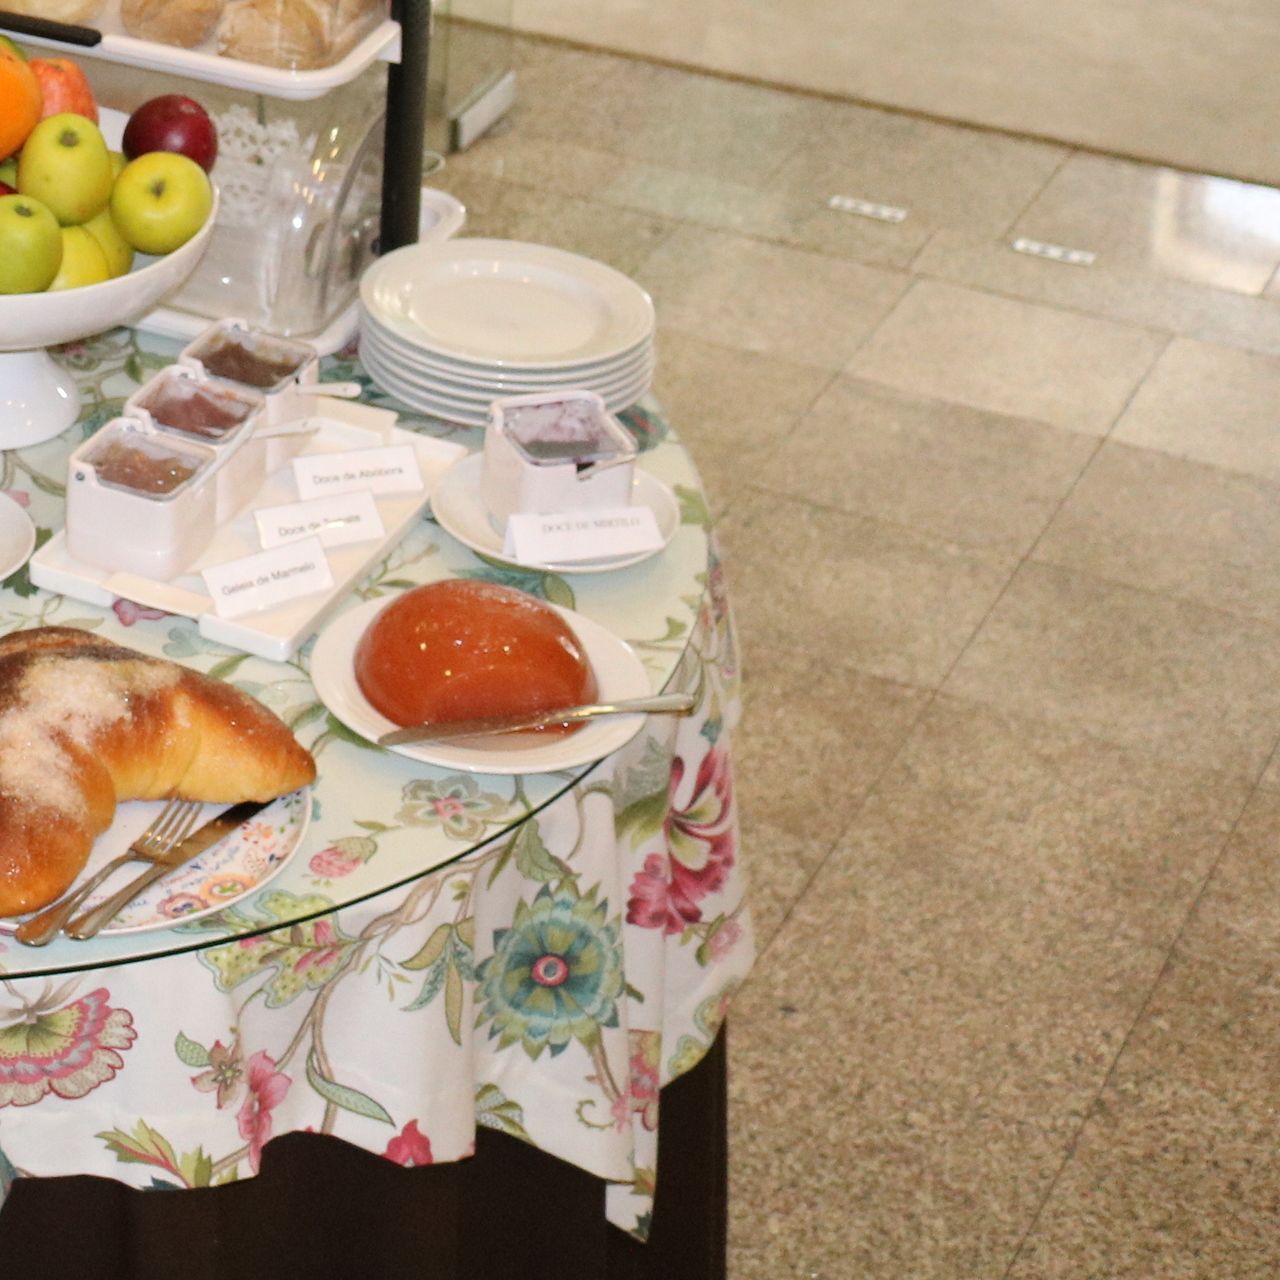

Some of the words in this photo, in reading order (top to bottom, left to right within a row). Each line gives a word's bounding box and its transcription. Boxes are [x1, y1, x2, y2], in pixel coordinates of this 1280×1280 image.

[312, 473, 341, 485] Doce
[343, 471, 357, 481] de
[277, 524, 306, 537] Doce
[221, 580, 255, 596] Geleia
[256, 575, 270, 586] de
[271, 561, 316, 580] Marmelo
